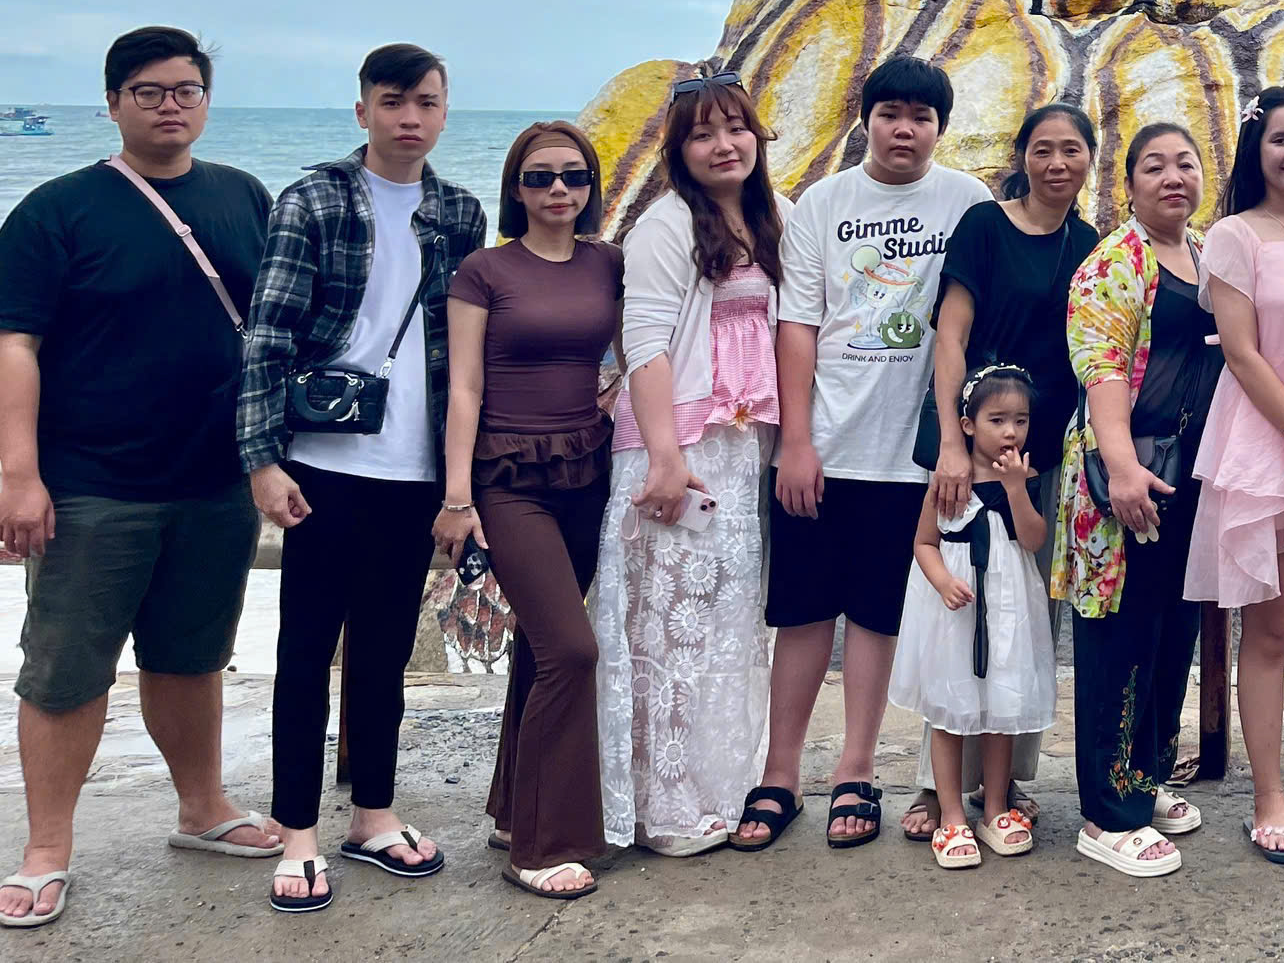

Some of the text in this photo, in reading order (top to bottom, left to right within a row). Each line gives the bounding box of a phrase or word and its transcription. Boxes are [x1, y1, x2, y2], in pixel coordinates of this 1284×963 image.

[837, 217, 924, 243] Gimme
[883, 231, 951, 260] Studi
[842, 353, 914, 363] DRINK AND ENJOY
